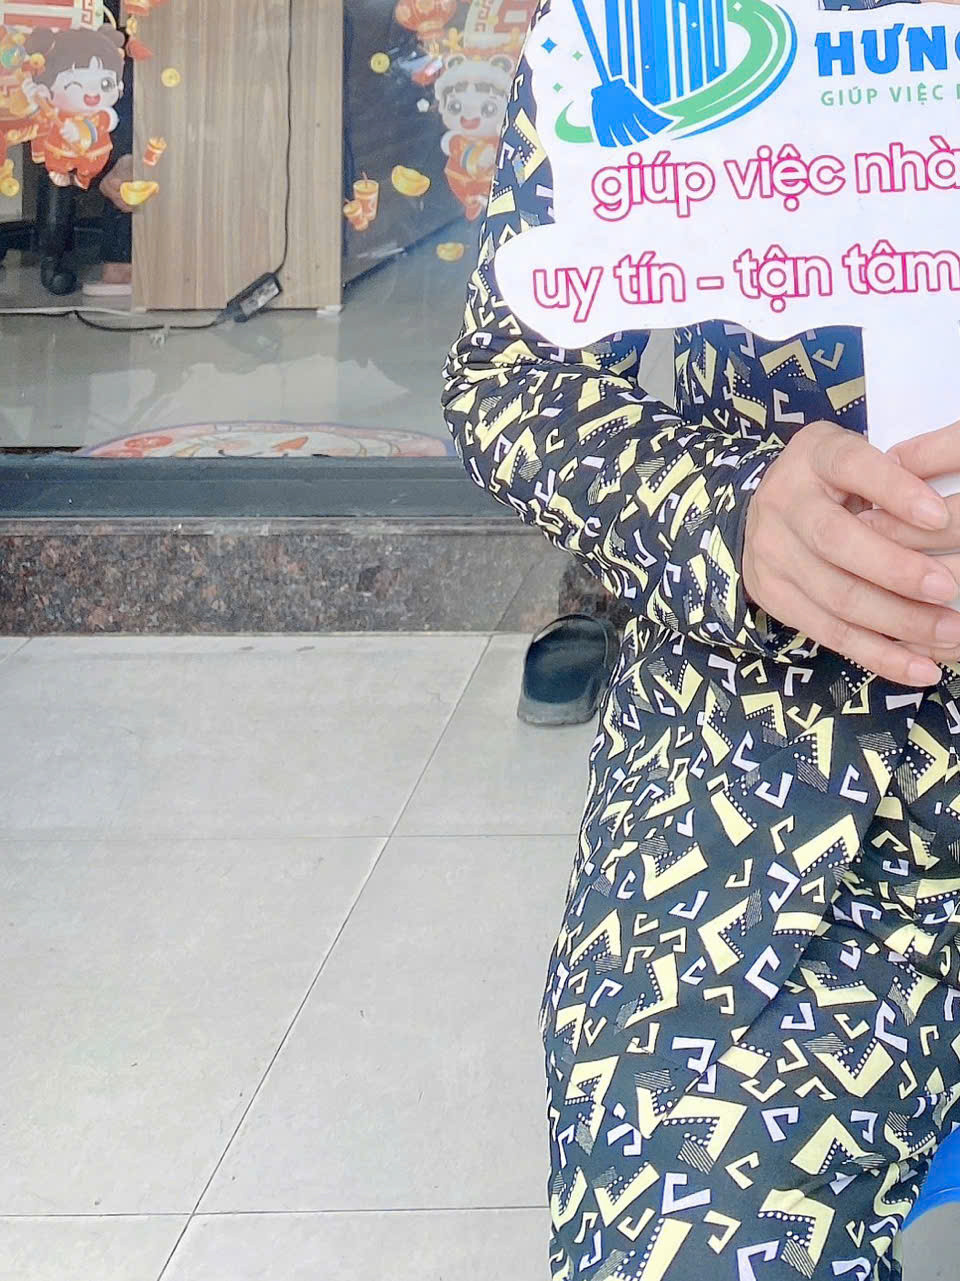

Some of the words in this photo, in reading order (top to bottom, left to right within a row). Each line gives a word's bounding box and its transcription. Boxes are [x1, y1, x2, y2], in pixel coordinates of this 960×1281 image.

[820, 85, 879, 107] GIÚP
[889, 81, 945, 107] VIỆC
[590, 150, 717, 223] giúp
[723, 143, 848, 213] việc
[532, 265, 603, 323] uy
[612, 250, 687, 305] tín
[733, 244, 833, 314] tận
